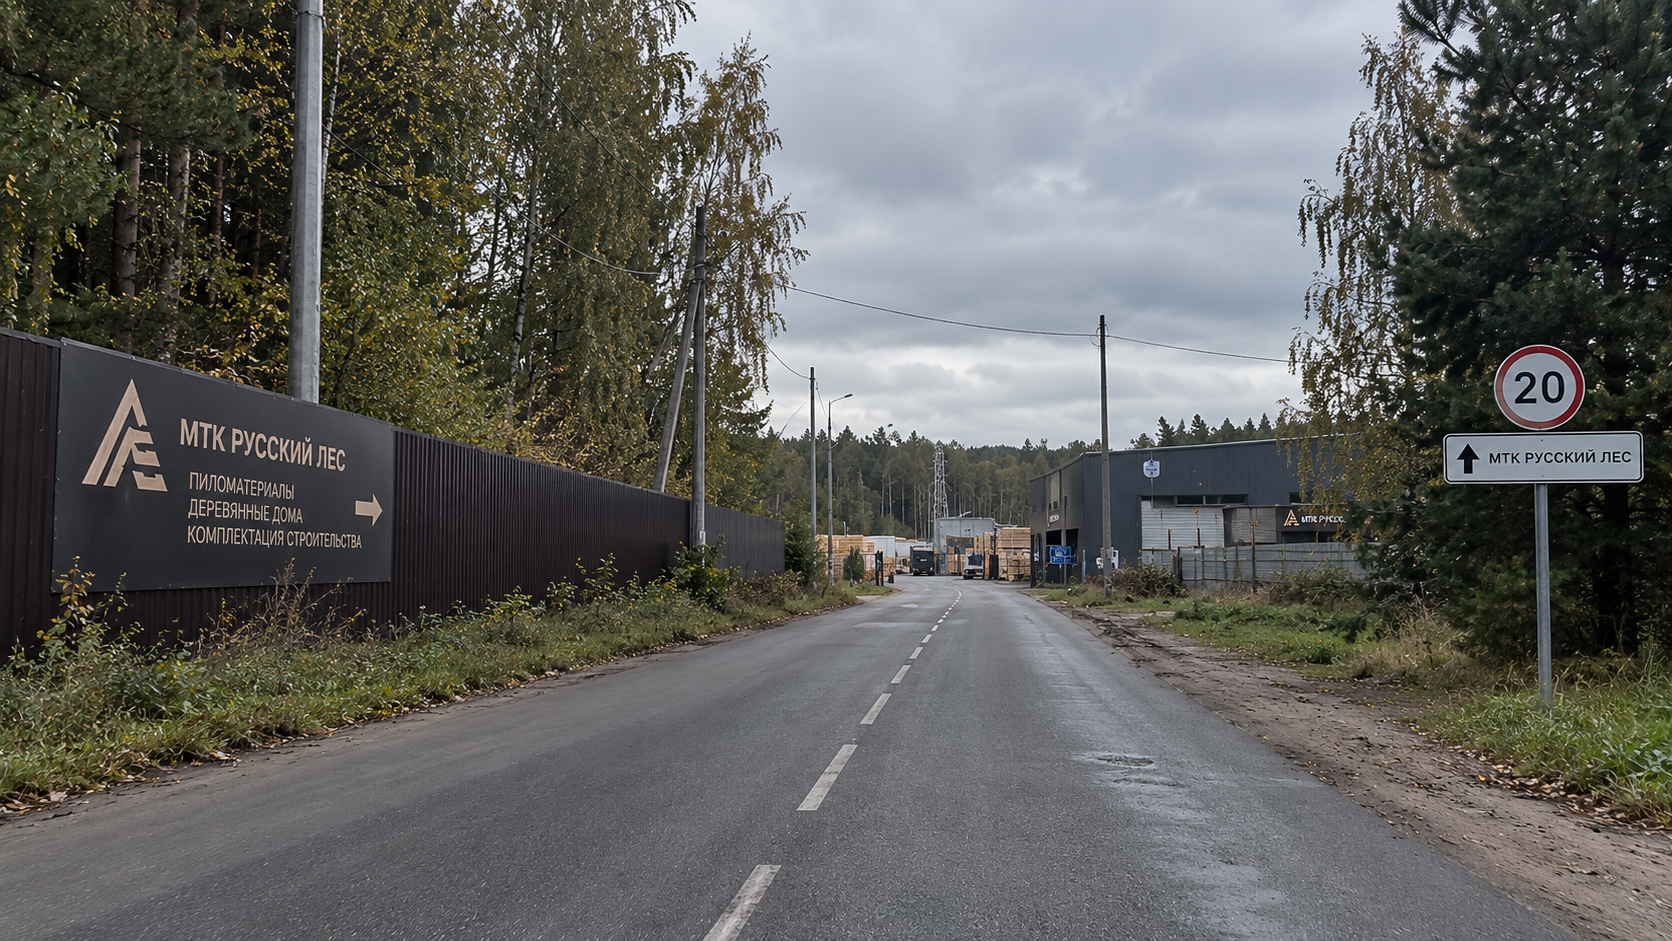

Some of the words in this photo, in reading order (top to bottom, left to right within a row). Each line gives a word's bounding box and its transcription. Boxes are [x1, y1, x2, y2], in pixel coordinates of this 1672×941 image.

[1514, 371, 1565, 404] 20
[180, 418, 226, 451] МТК
[231, 428, 312, 465] РУССКИЙ
[316, 445, 346, 471] ЛЕС
[1489, 452, 1521, 464] МТК
[1525, 449, 1596, 464] РУССКИЙ
[1600, 451, 1632, 463] ЛЕС
[189, 472, 295, 500] ПИЛОМАТЕРИАЛЫ
[188, 498, 270, 522] ДЕРЕВЯННЫЕ
[272, 505, 303, 525] ДОМА
[187, 525, 284, 548] КОМПЛЕКТАЦИЯ
[286, 531, 362, 549] СТРОИТЕЛЬСТВА
